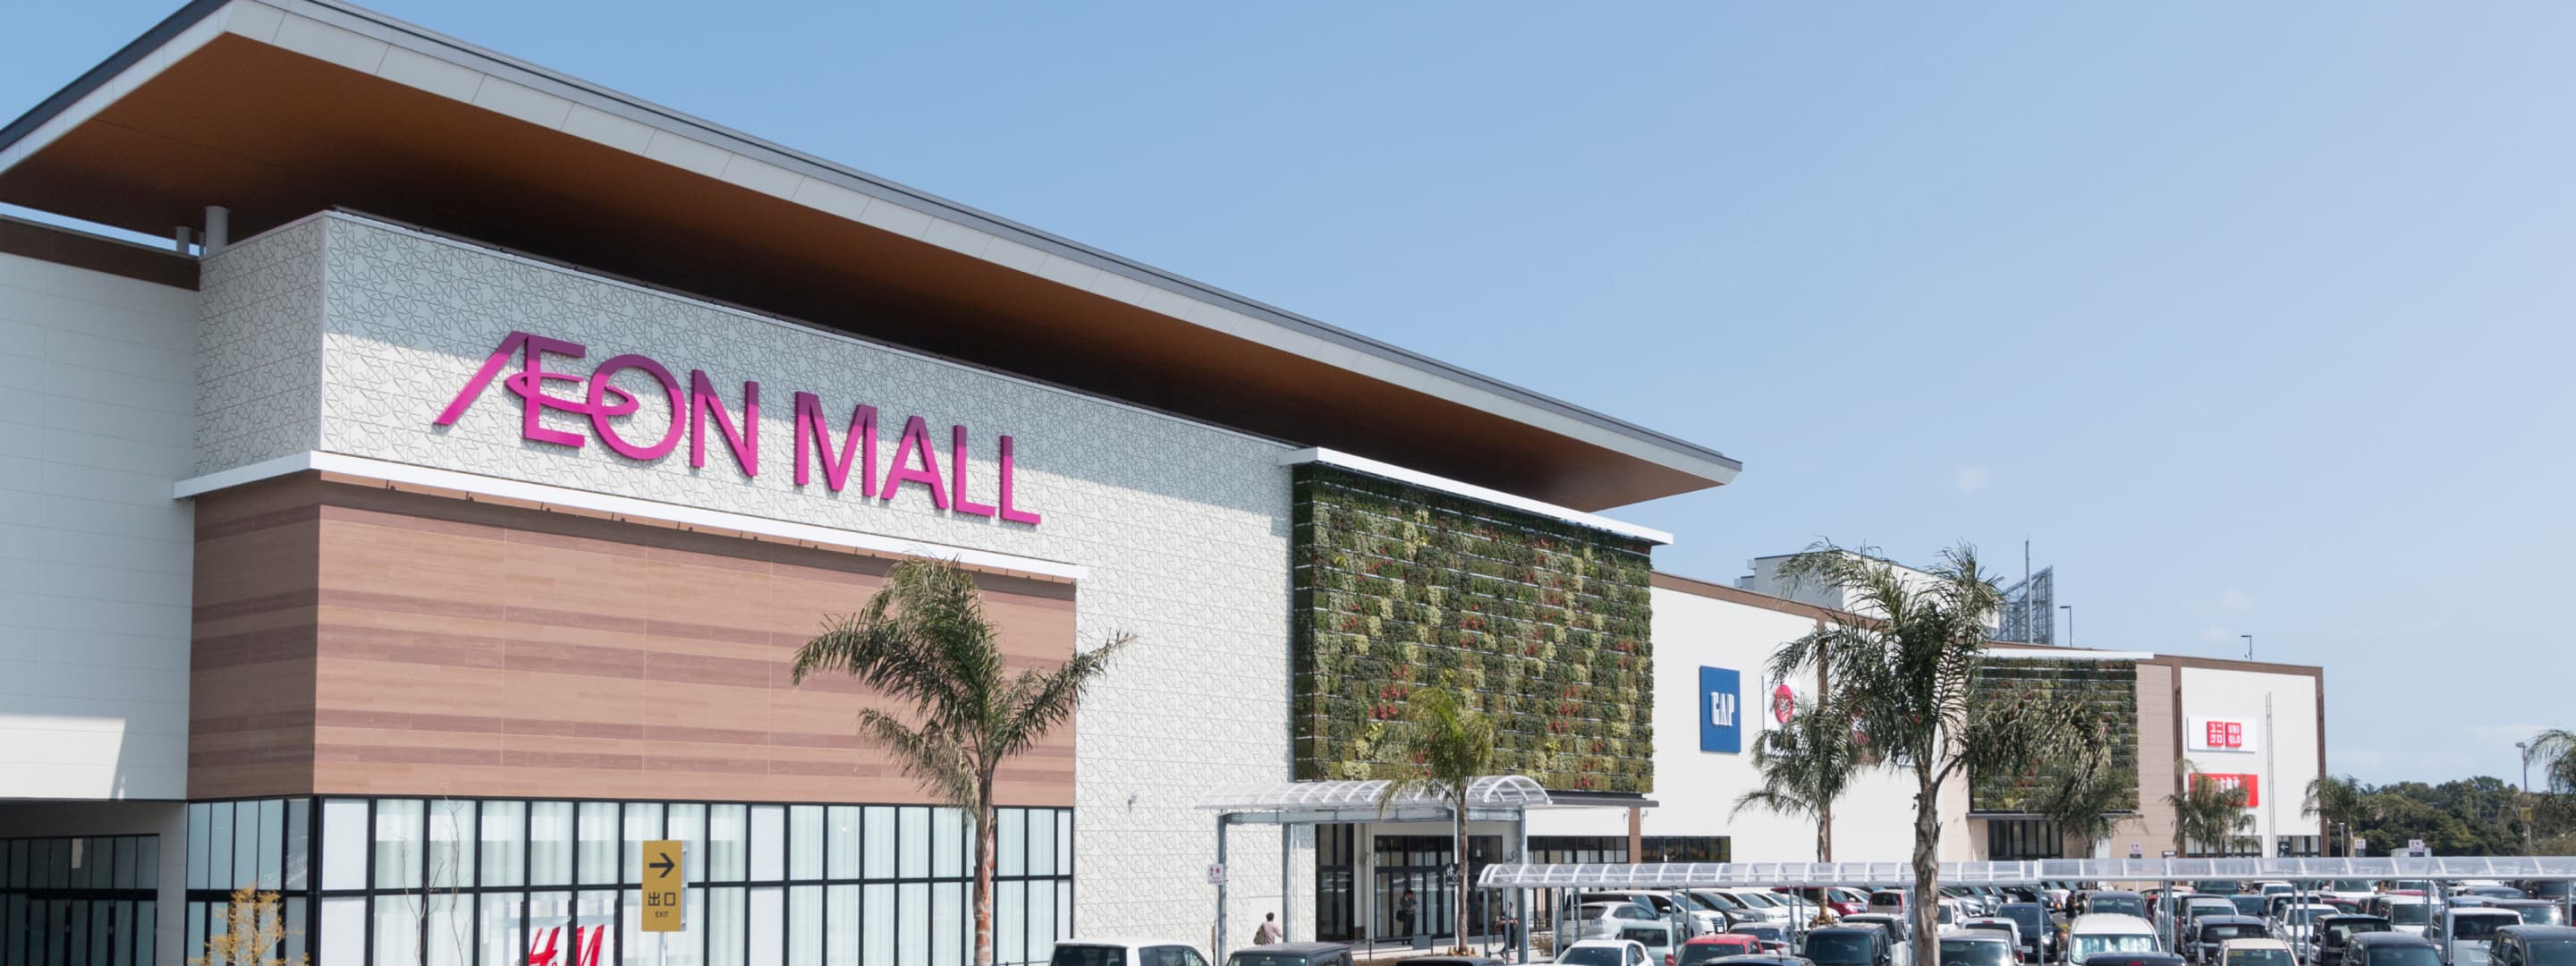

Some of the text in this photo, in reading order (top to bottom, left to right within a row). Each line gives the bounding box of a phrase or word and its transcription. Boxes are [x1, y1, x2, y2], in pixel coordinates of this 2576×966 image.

[794, 391, 1041, 525] MALL
[1710, 692, 1734, 726] GAP
[648, 891, 676, 907] 出口
